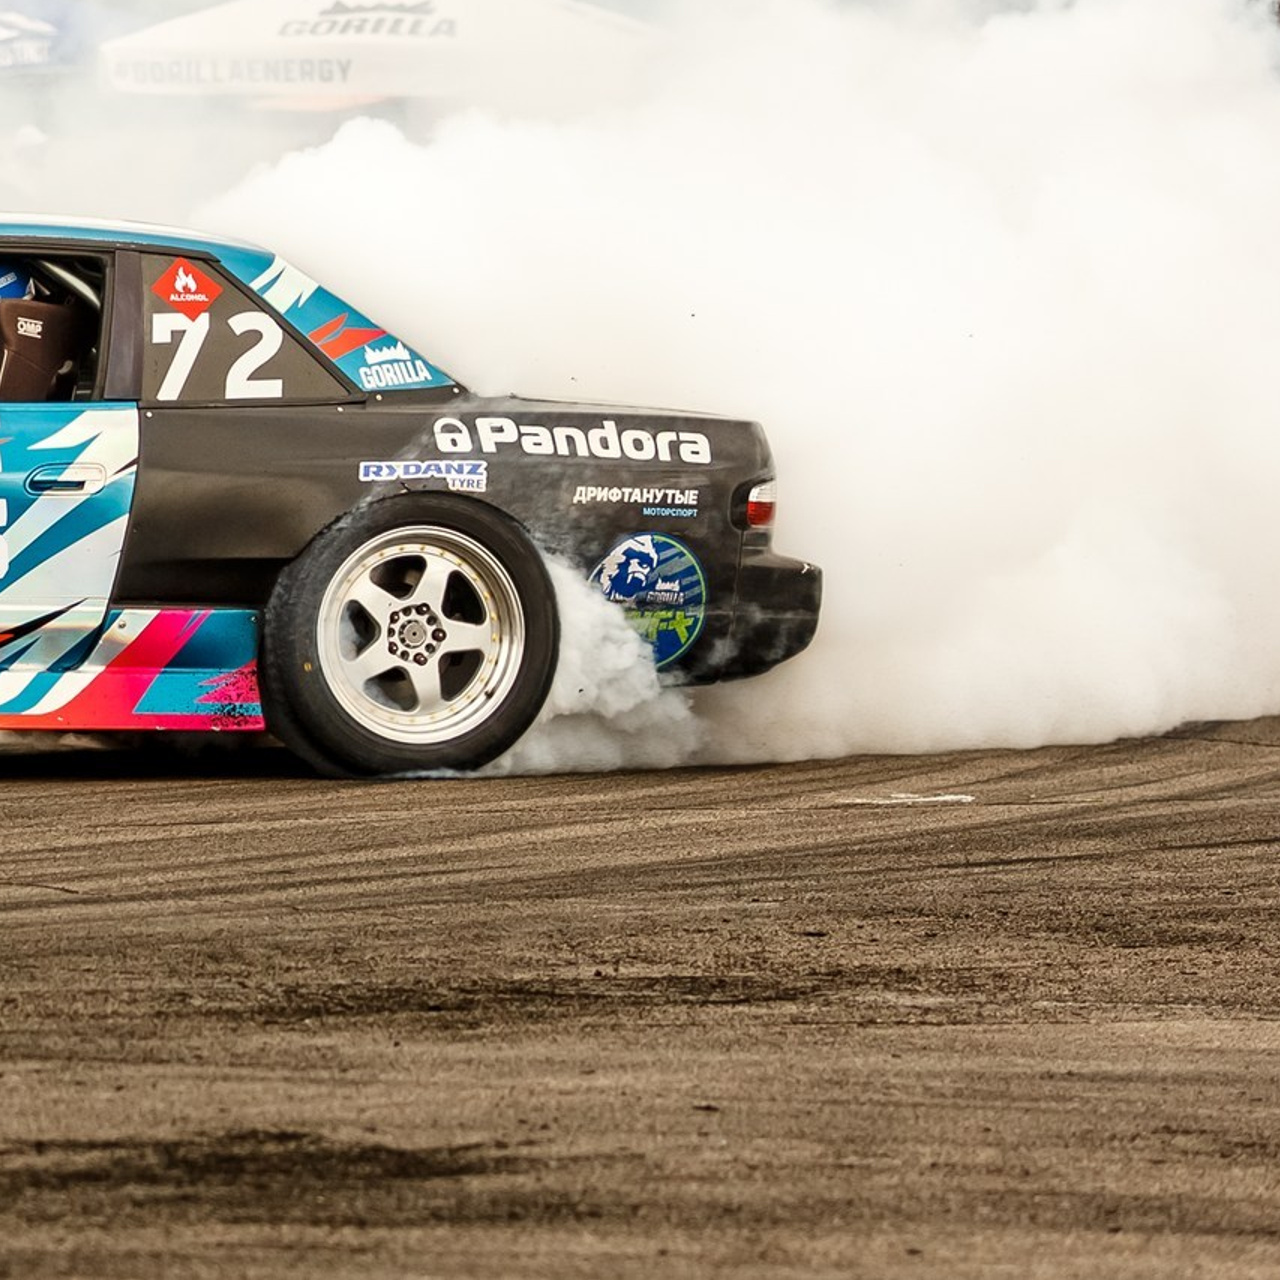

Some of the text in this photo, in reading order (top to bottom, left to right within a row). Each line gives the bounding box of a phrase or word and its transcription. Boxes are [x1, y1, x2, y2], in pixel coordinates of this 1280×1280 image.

[277, 16, 457, 37] GORILLA
[169, 293, 209, 302] ALCOHOL
[17, 320, 43, 334] OMP
[152, 311, 283, 401] 72
[358, 360, 432, 389] GORILLA
[474, 418, 711, 464] Pandora
[451, 478, 482, 489] TYRE
[572, 486, 699, 505] ДРИФТАНУТЫЕ
[642, 507, 698, 517] МОТОРСПОРТ
